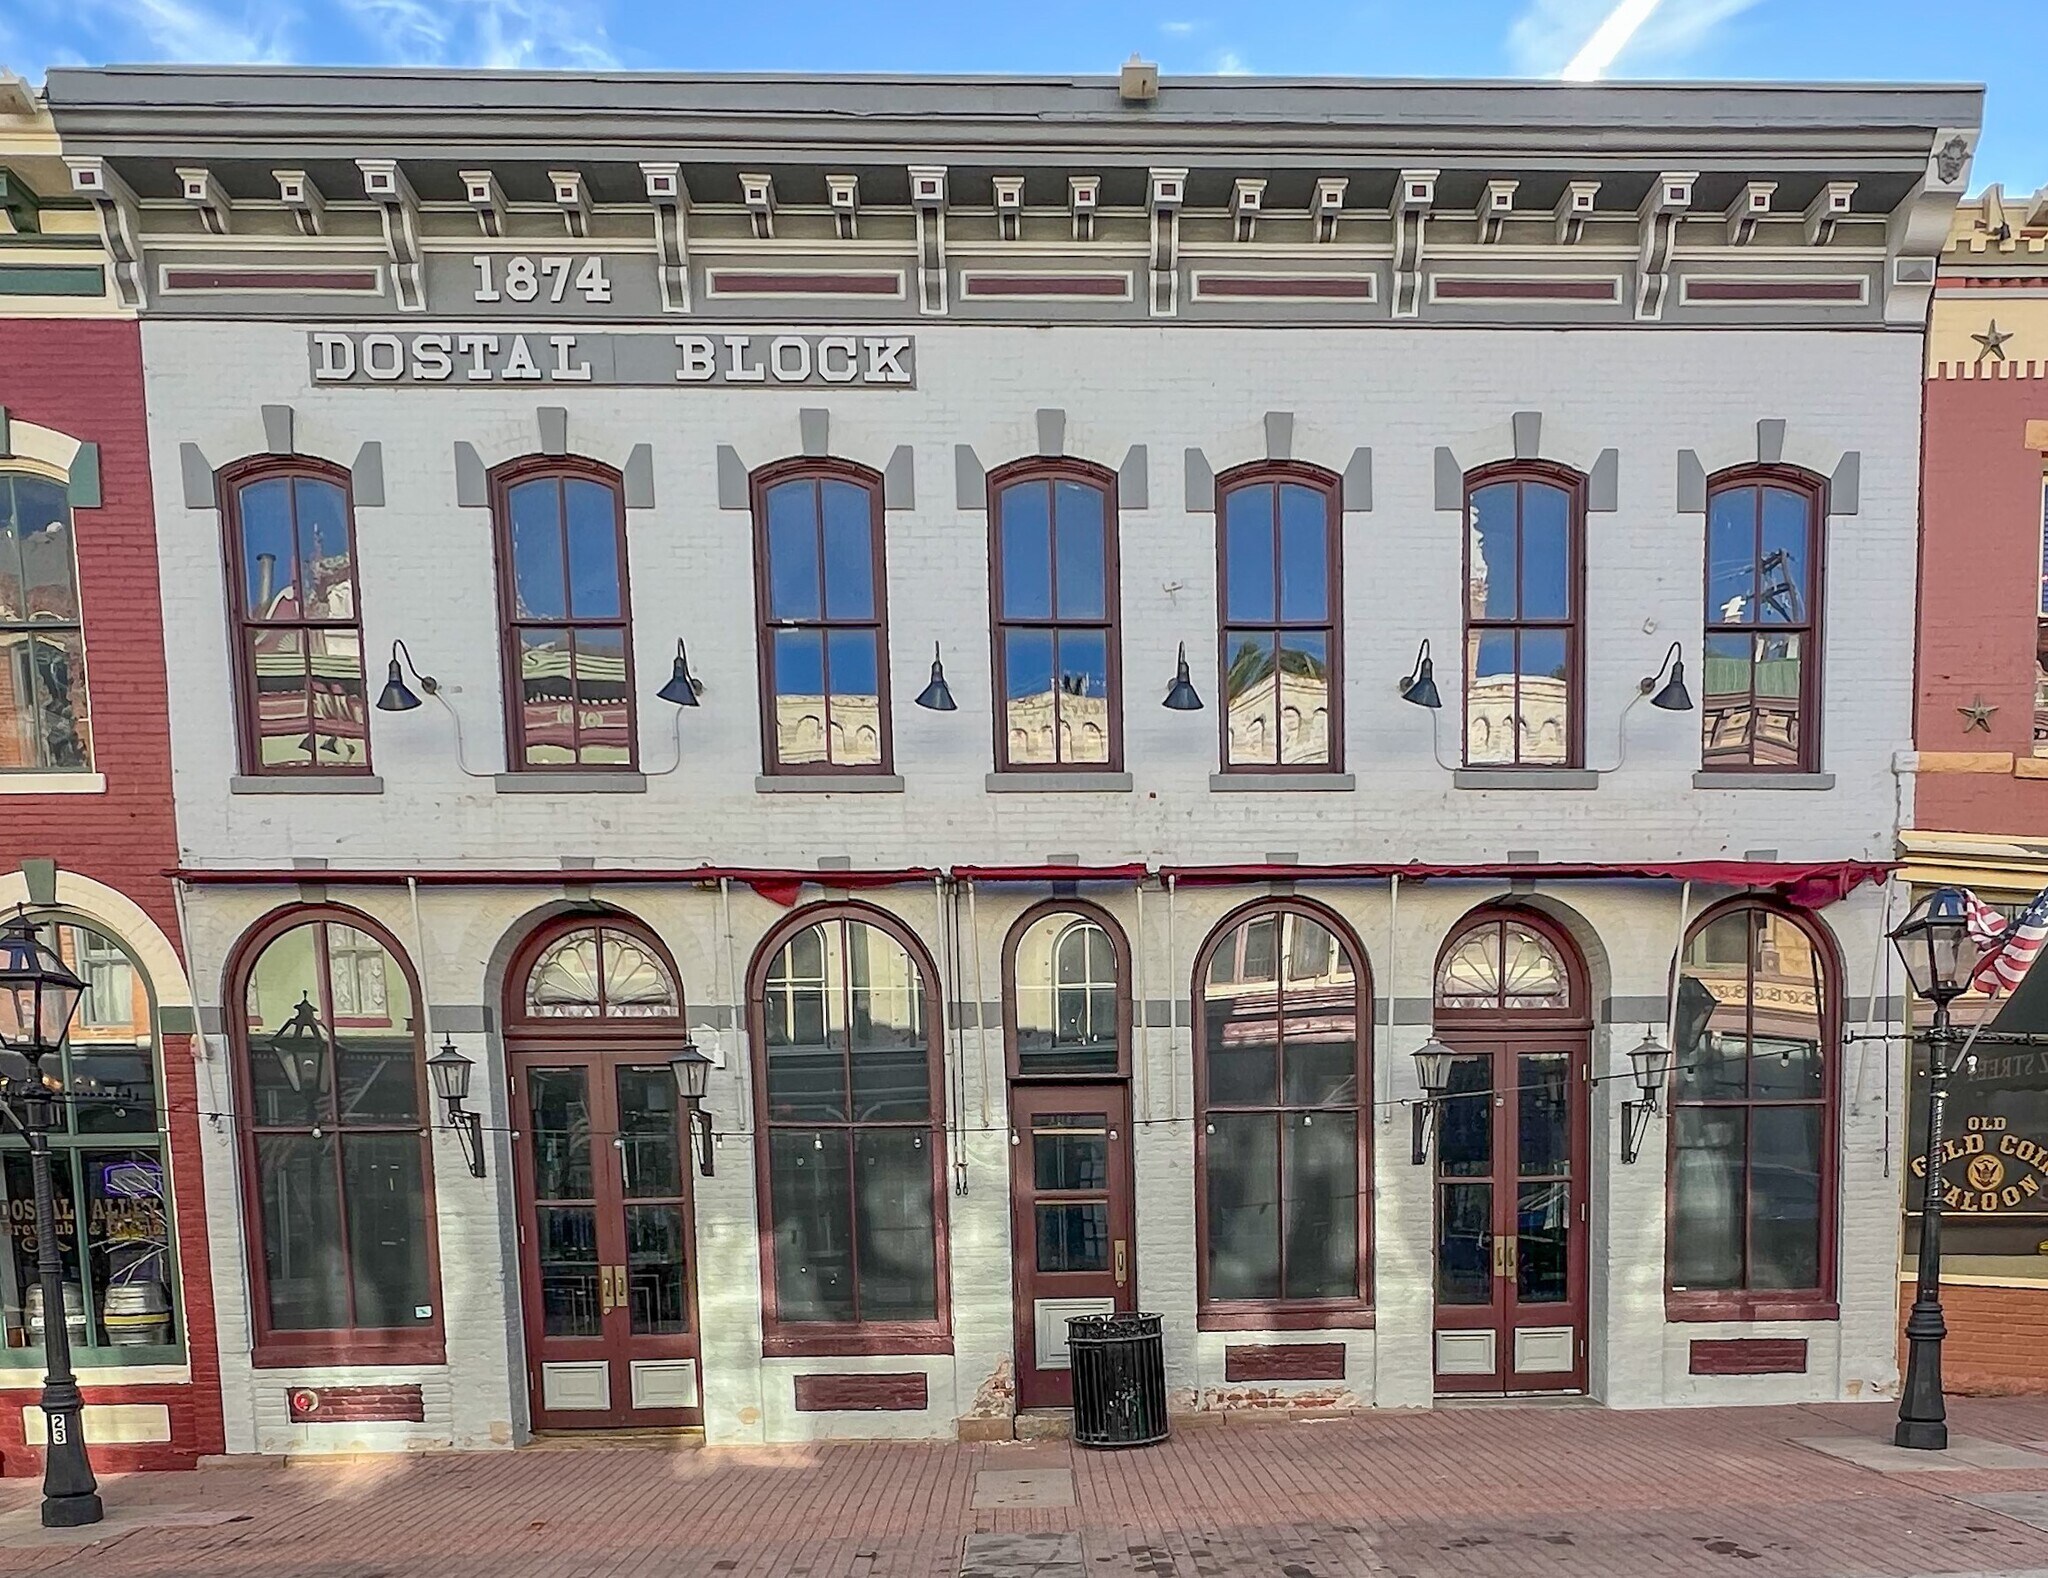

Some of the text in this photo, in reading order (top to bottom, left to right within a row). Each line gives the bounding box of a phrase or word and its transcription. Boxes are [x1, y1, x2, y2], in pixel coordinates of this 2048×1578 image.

[473, 256, 611, 302] 1874
[314, 333, 911, 383] DOSTAL BLOCK
[1968, 1117, 2006, 1131] OLD
[1911, 1134, 1985, 1177] GLD
[0, 1199, 74, 1221] DOSAL
